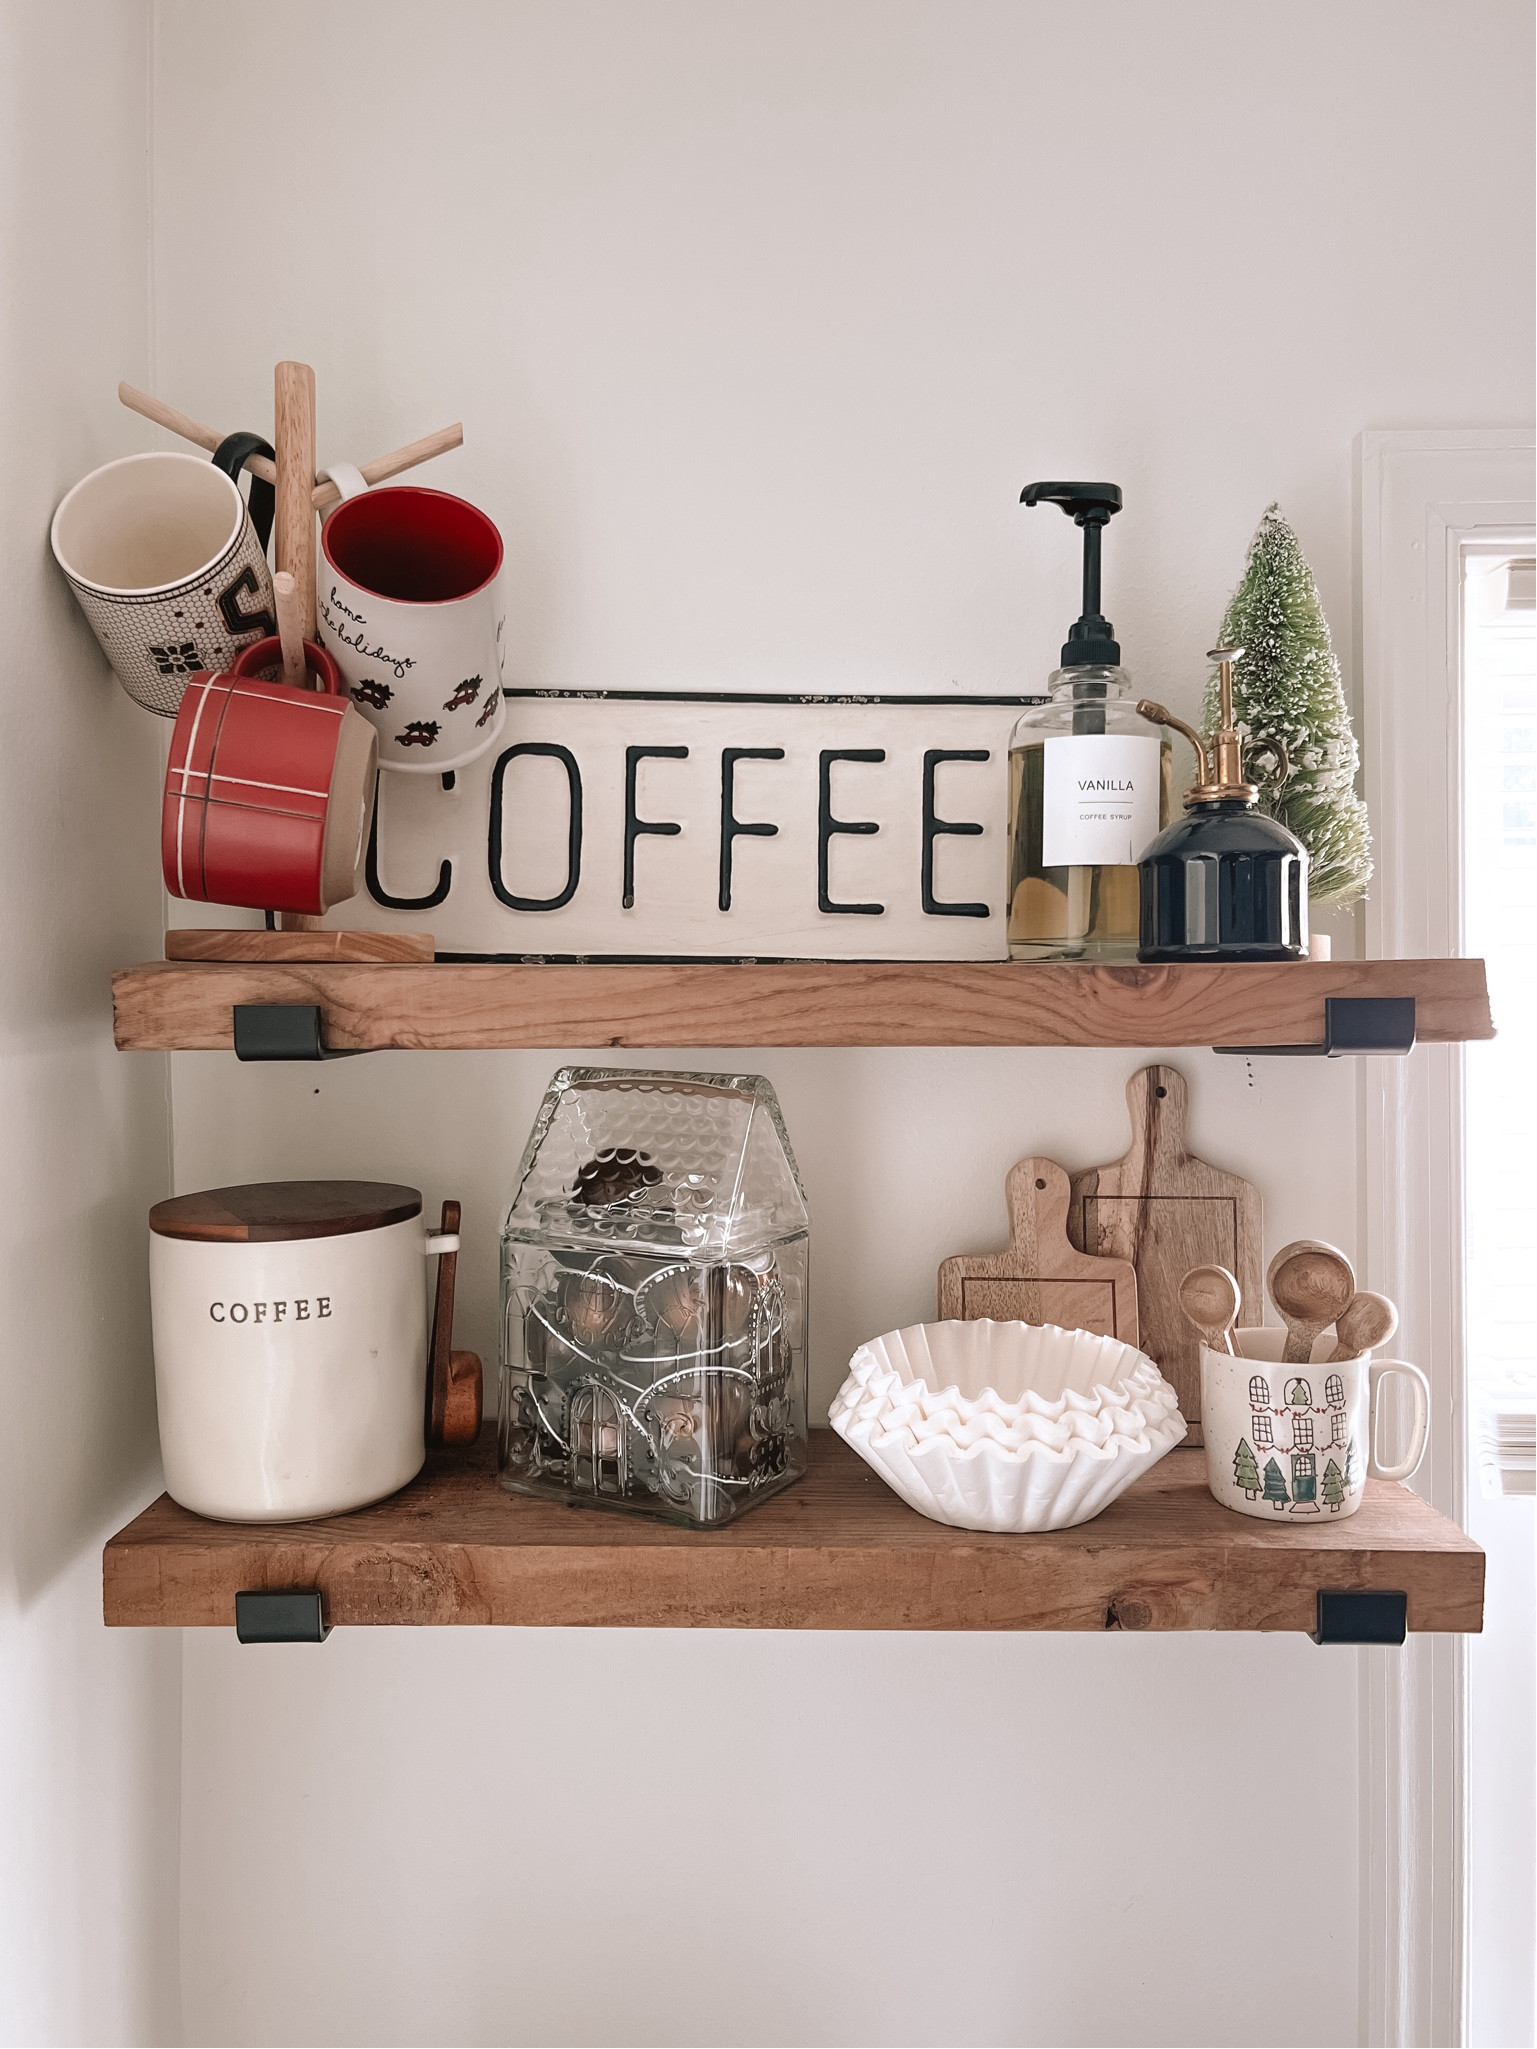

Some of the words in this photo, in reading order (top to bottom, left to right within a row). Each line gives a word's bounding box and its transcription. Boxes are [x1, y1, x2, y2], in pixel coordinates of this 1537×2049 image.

[330, 586, 367, 624] home
[338, 622, 417, 679] holidays
[1078, 780, 1134, 791] VANILLA
[365, 742, 991, 919] COFFEE
[1079, 813, 1107, 821] COFFEE
[1109, 813, 1132, 821] SYRUP
[209, 1296, 333, 1324] COFFEE
